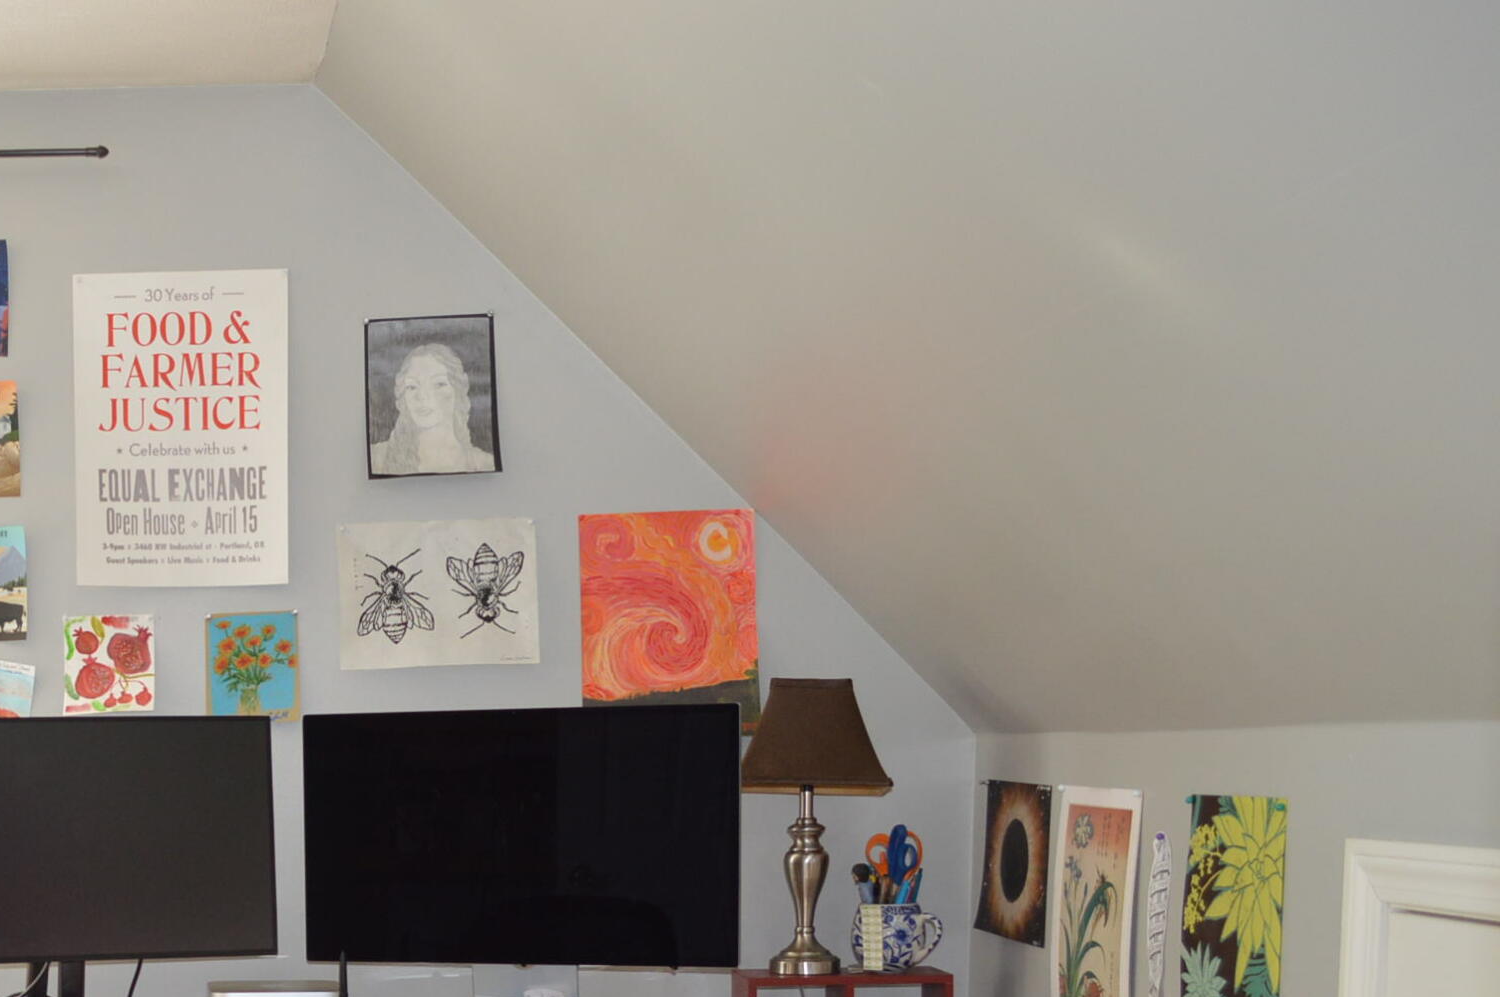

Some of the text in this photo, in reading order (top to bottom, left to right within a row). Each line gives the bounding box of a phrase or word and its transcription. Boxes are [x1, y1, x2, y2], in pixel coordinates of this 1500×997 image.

[144, 286, 215, 302] 30 Years of
[106, 310, 252, 348] FOOD &
[100, 351, 263, 391] FARMER
[98, 394, 261, 432] JUSTICE
[129, 441, 236, 457] Celebrate with us
[98, 466, 268, 503] EQUAL EXCHANGE
[106, 505, 258, 536] Open House April 15
